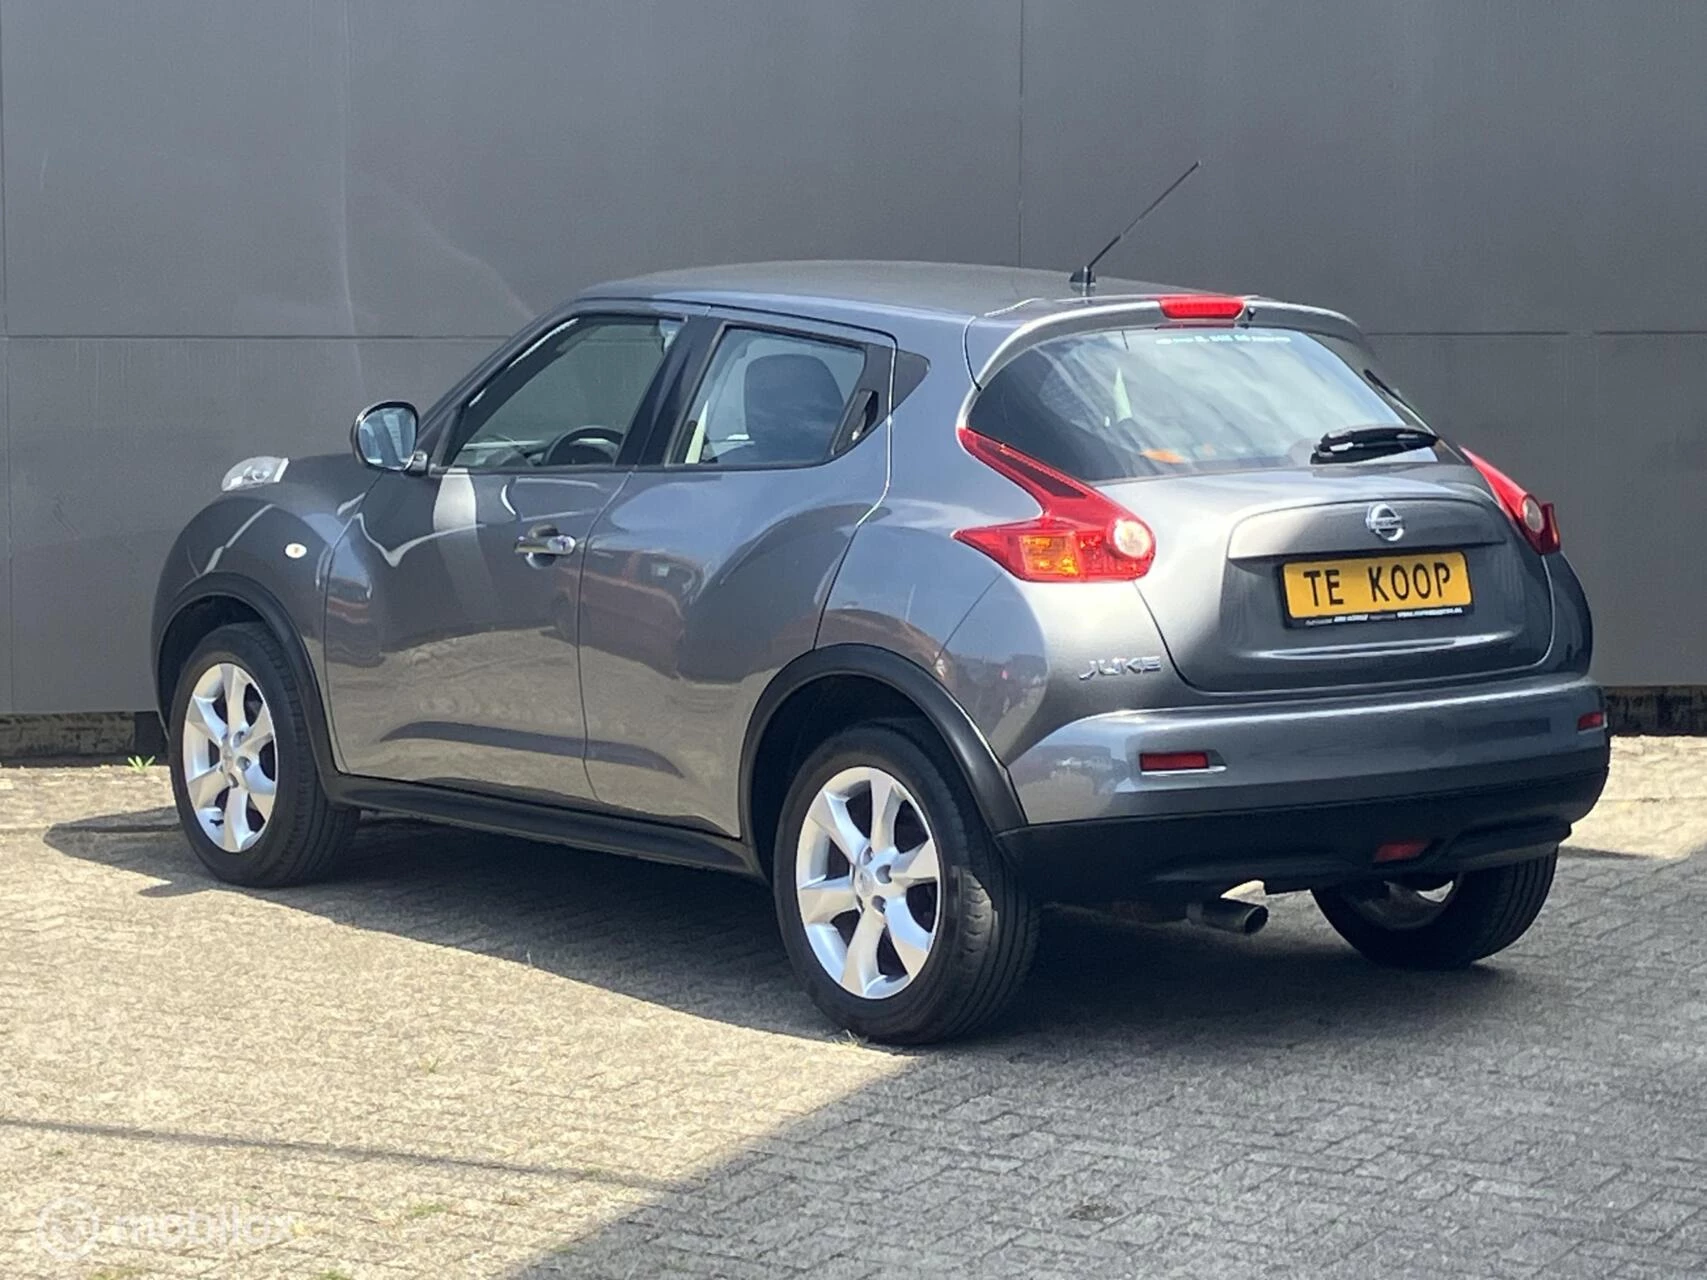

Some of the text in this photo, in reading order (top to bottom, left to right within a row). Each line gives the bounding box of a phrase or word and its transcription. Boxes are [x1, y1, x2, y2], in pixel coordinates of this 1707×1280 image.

[1303, 562, 1451, 607] TE KOOP
[1079, 656, 1161, 681] JUKE
